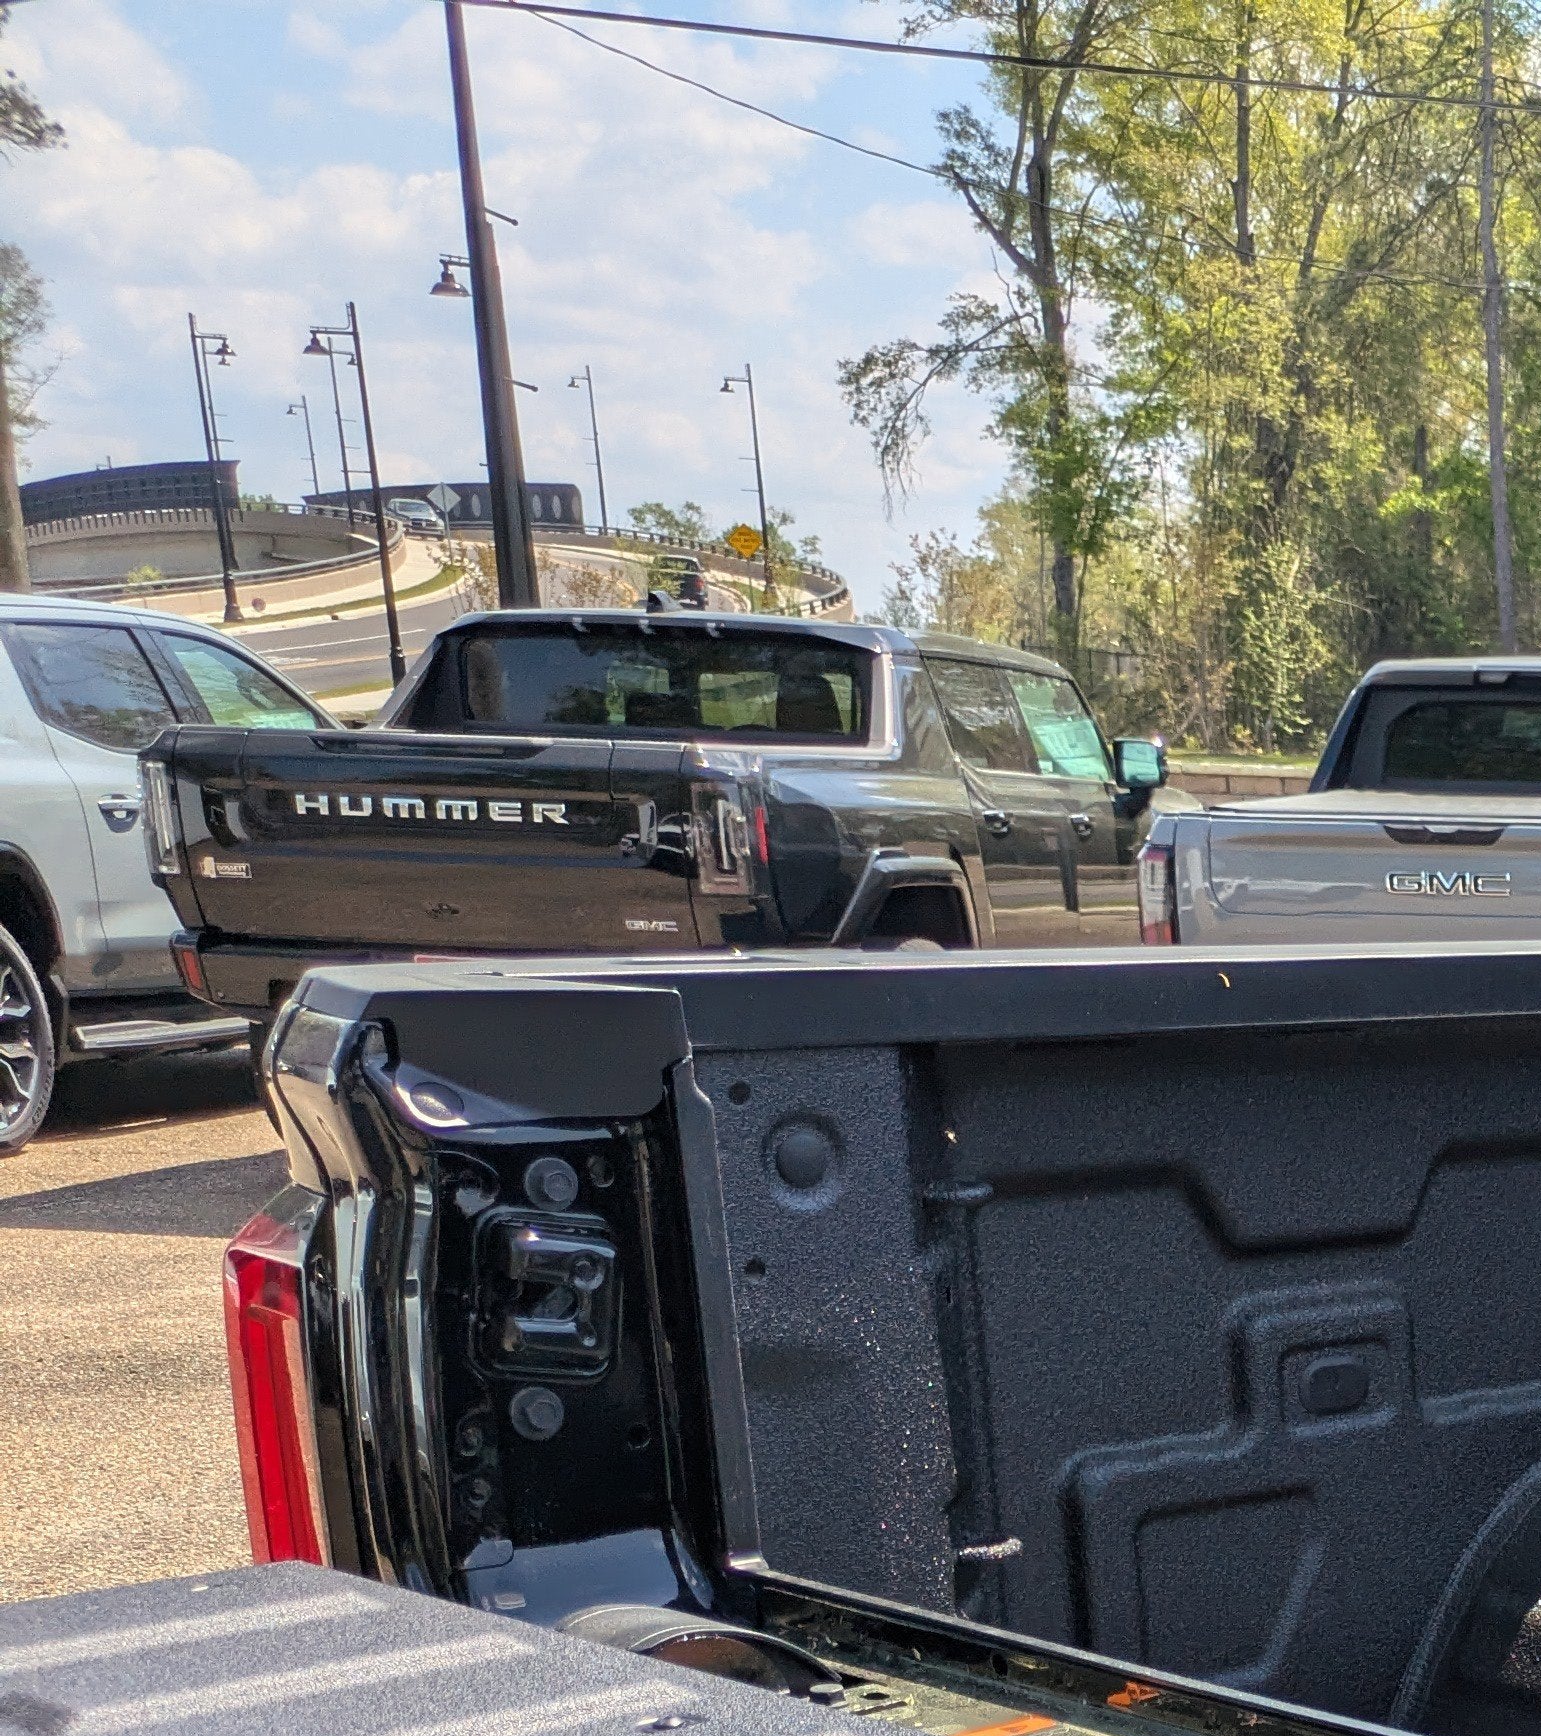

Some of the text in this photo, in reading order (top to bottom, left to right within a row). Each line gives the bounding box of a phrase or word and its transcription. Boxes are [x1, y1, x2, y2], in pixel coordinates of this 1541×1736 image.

[295, 794, 569, 825] HUMMER
[1385, 871, 1511, 896] GMC
[625, 920, 679, 931] GMC
